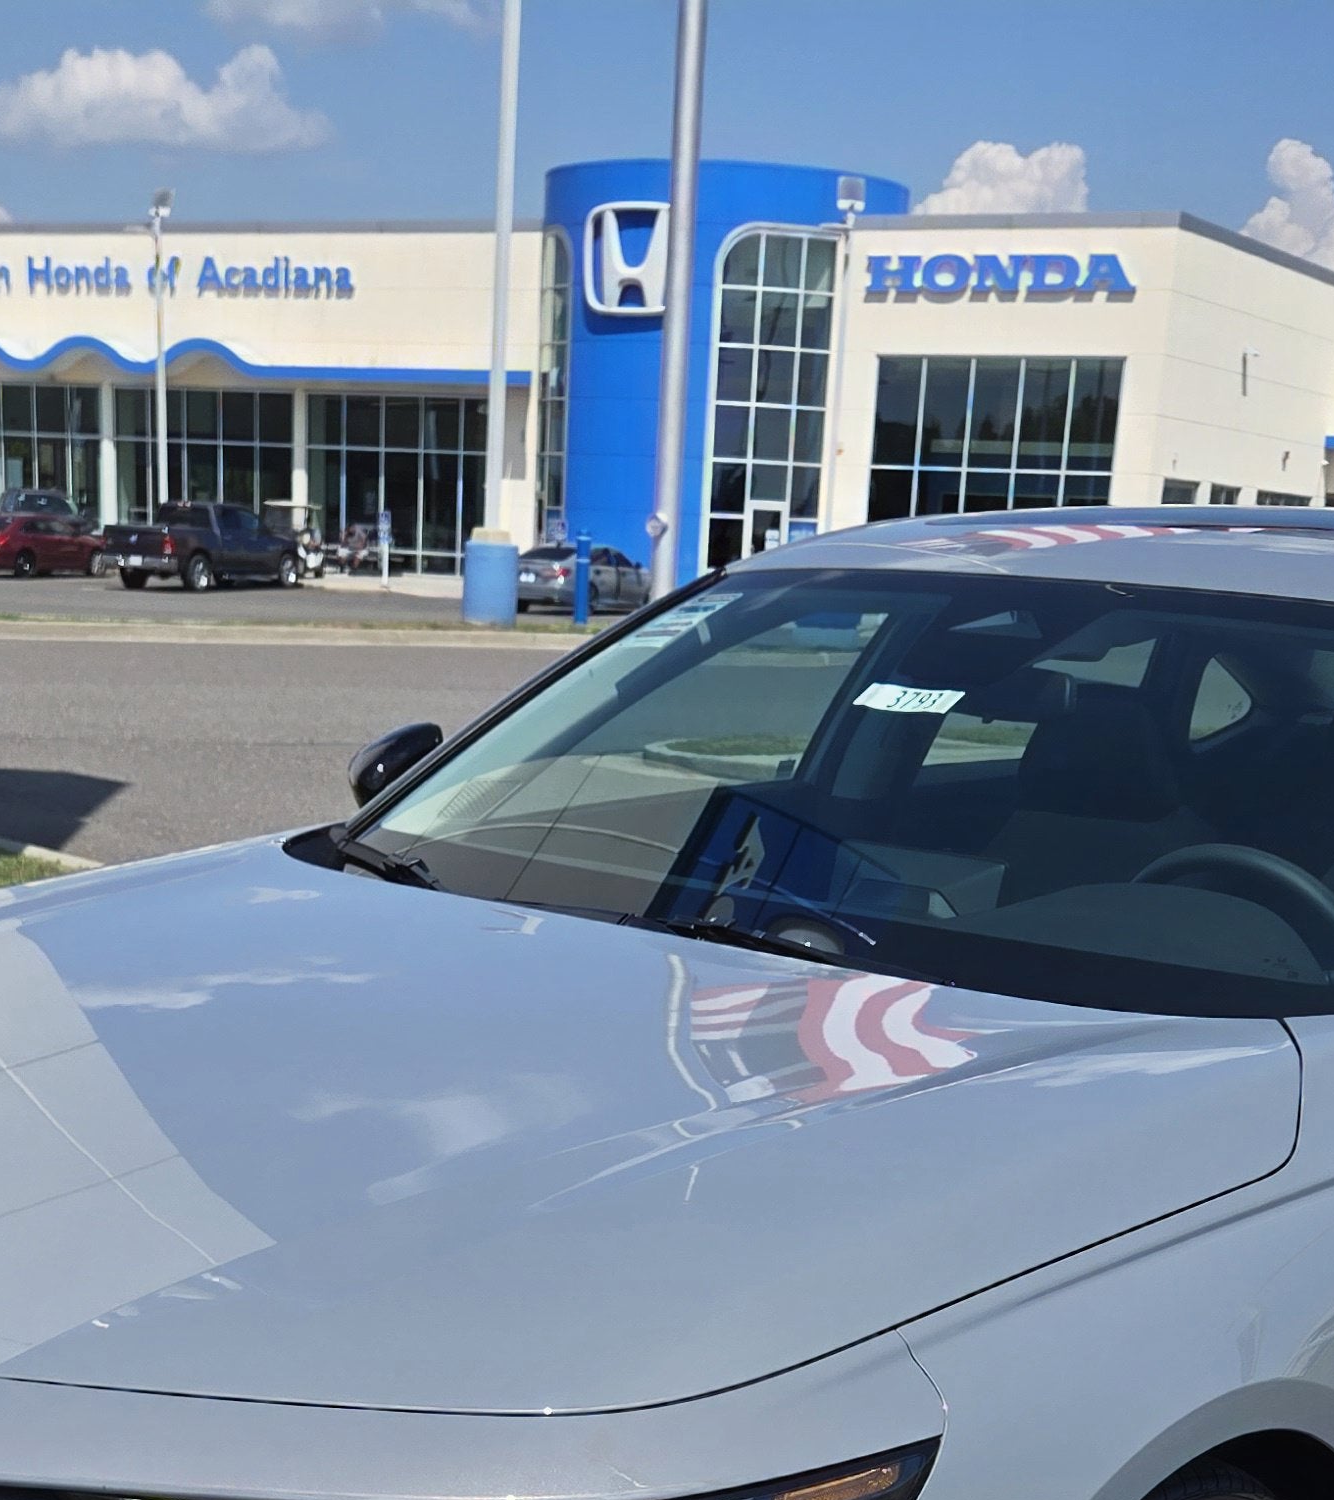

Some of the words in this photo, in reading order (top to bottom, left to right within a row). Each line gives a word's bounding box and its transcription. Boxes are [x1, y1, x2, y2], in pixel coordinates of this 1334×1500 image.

[27, 256, 131, 295] Honda
[147, 256, 180, 296] of
[197, 256, 354, 298] Acadiana
[864, 253, 1136, 302] HONDA
